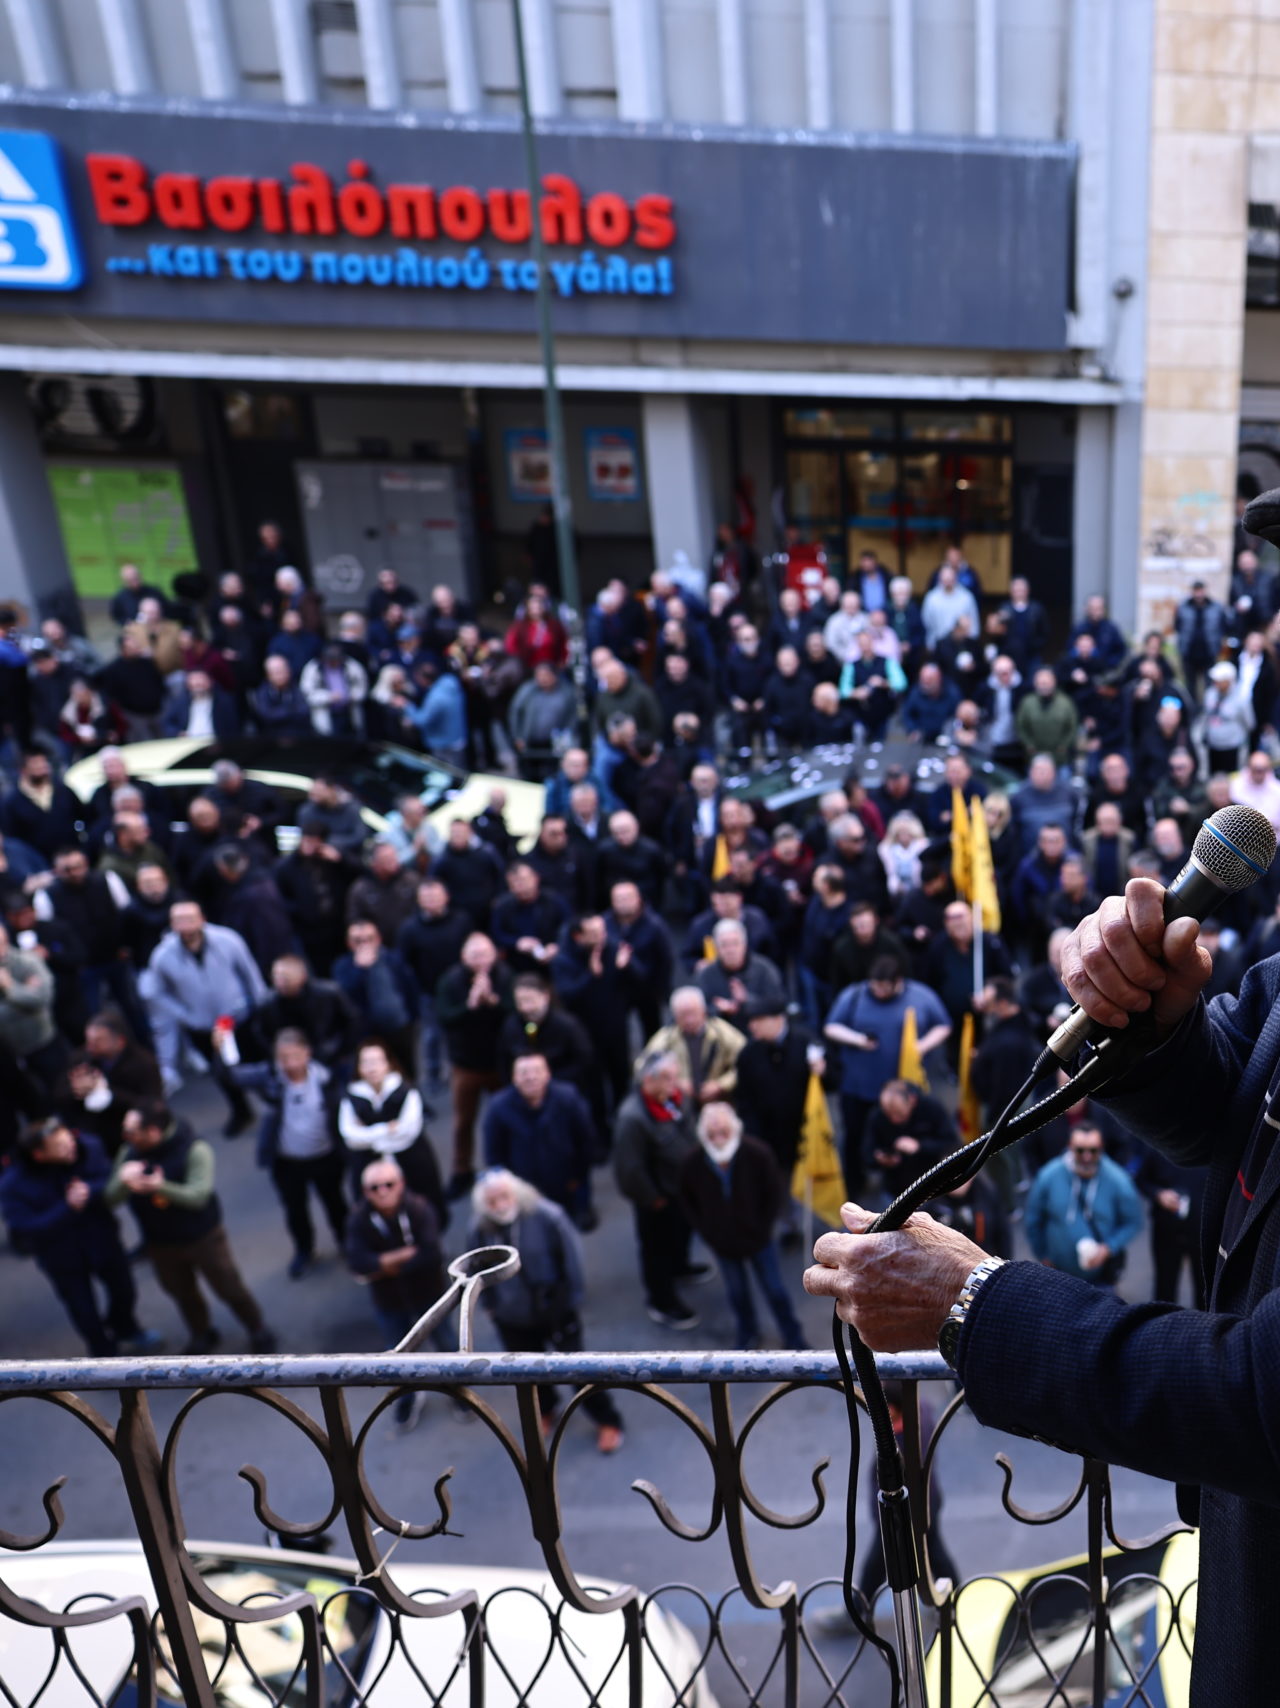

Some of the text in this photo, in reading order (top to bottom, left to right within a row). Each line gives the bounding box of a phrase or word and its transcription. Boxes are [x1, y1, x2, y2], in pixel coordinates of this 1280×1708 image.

[86, 155, 675, 248] Βασιλόπουλος
[228, 249, 302, 281] του
[312, 247, 488, 287] πουλιού
[551, 253, 674, 295] γάλα!
